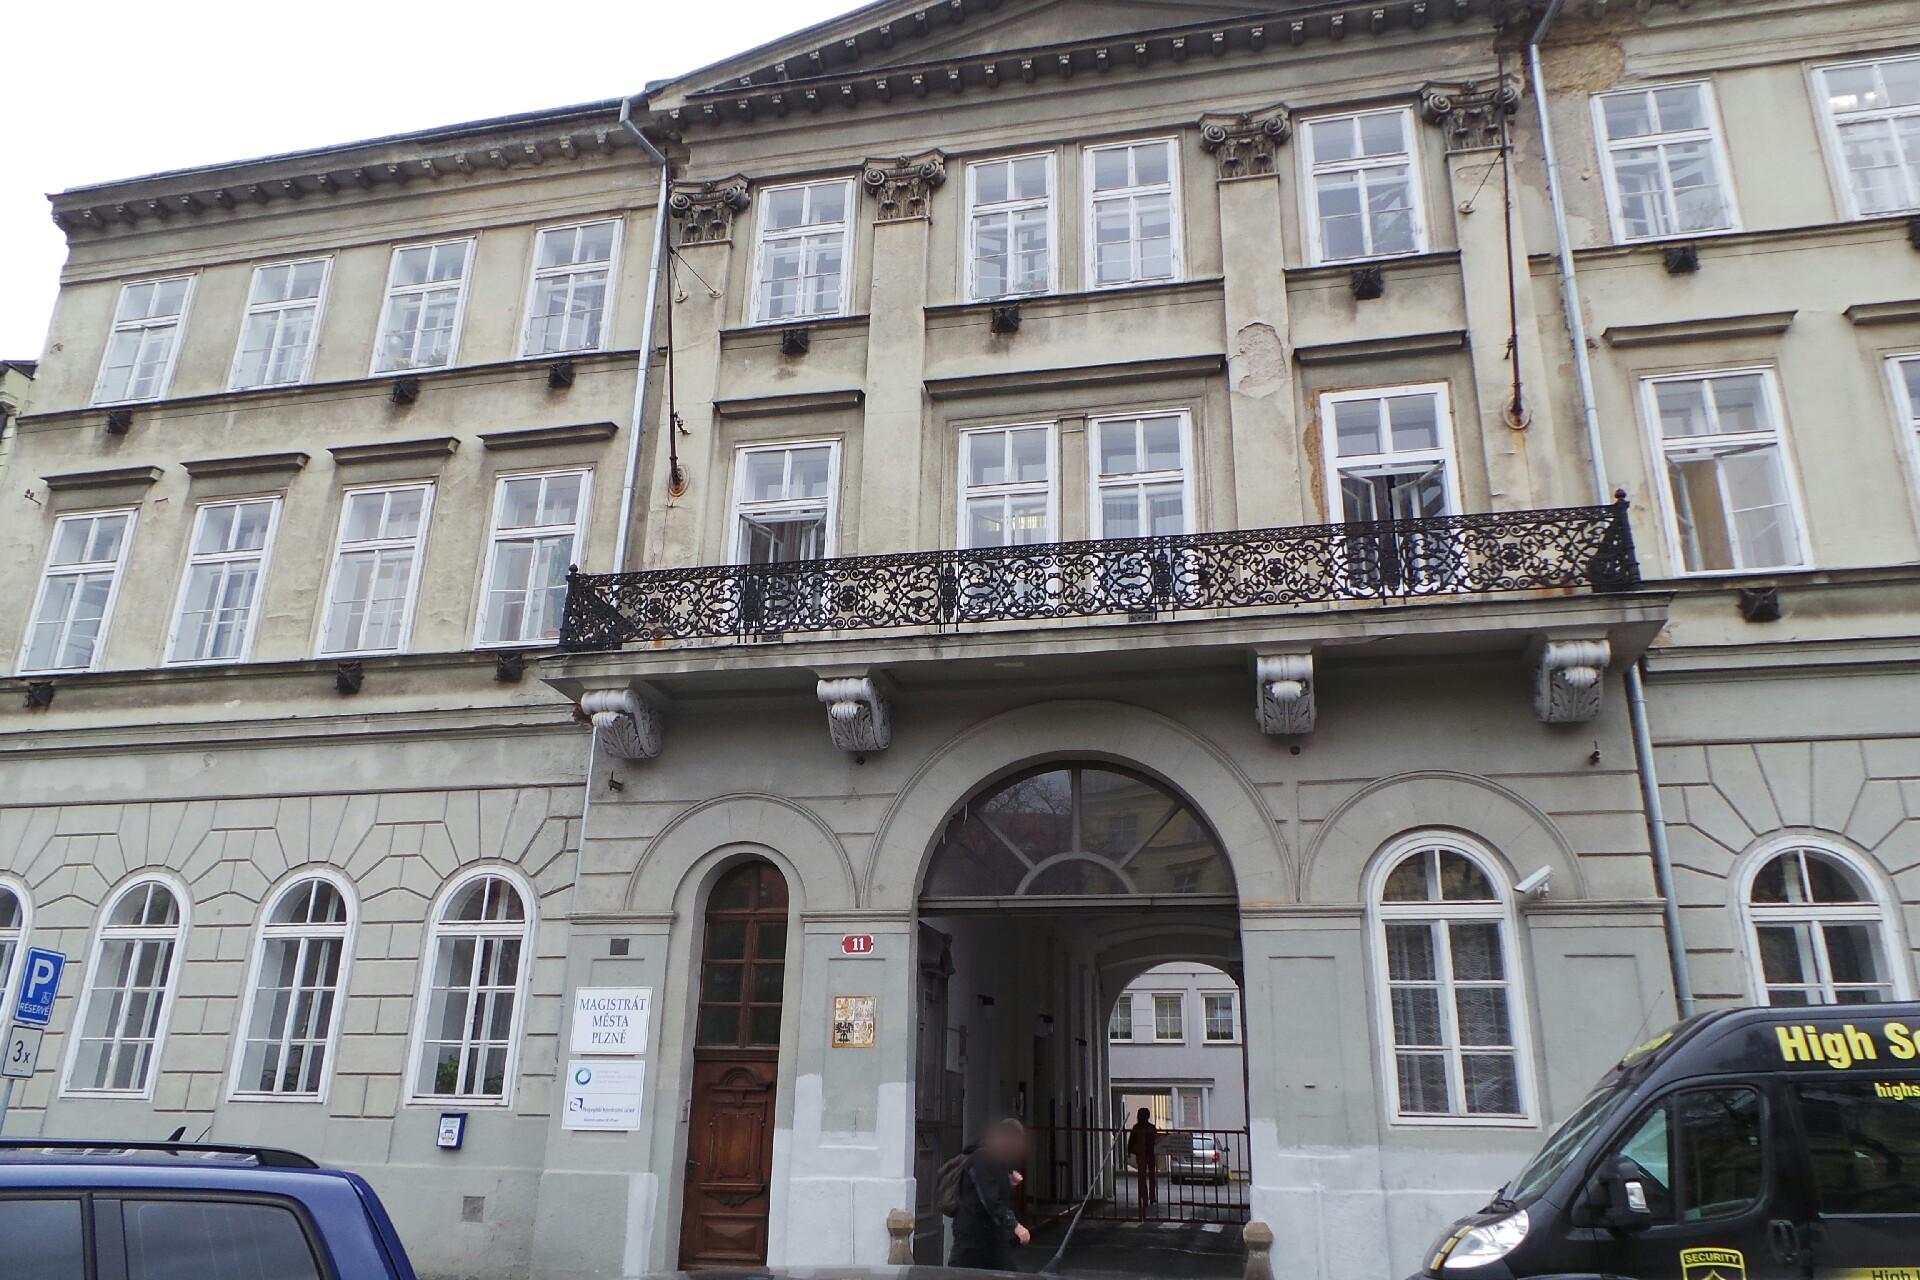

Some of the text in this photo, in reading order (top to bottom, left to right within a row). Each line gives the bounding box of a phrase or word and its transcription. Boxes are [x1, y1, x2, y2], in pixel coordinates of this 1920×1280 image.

[852, 937, 865, 951] 11
[27, 958, 55, 999] P
[579, 994, 647, 1011] MAGISTRÁT
[592, 1012, 629, 1028] MĚSTA
[591, 1029, 627, 1044] PLZNĚ
[1775, 1024, 1878, 1069] High
[1684, 1252, 1738, 1263] SECURITY
